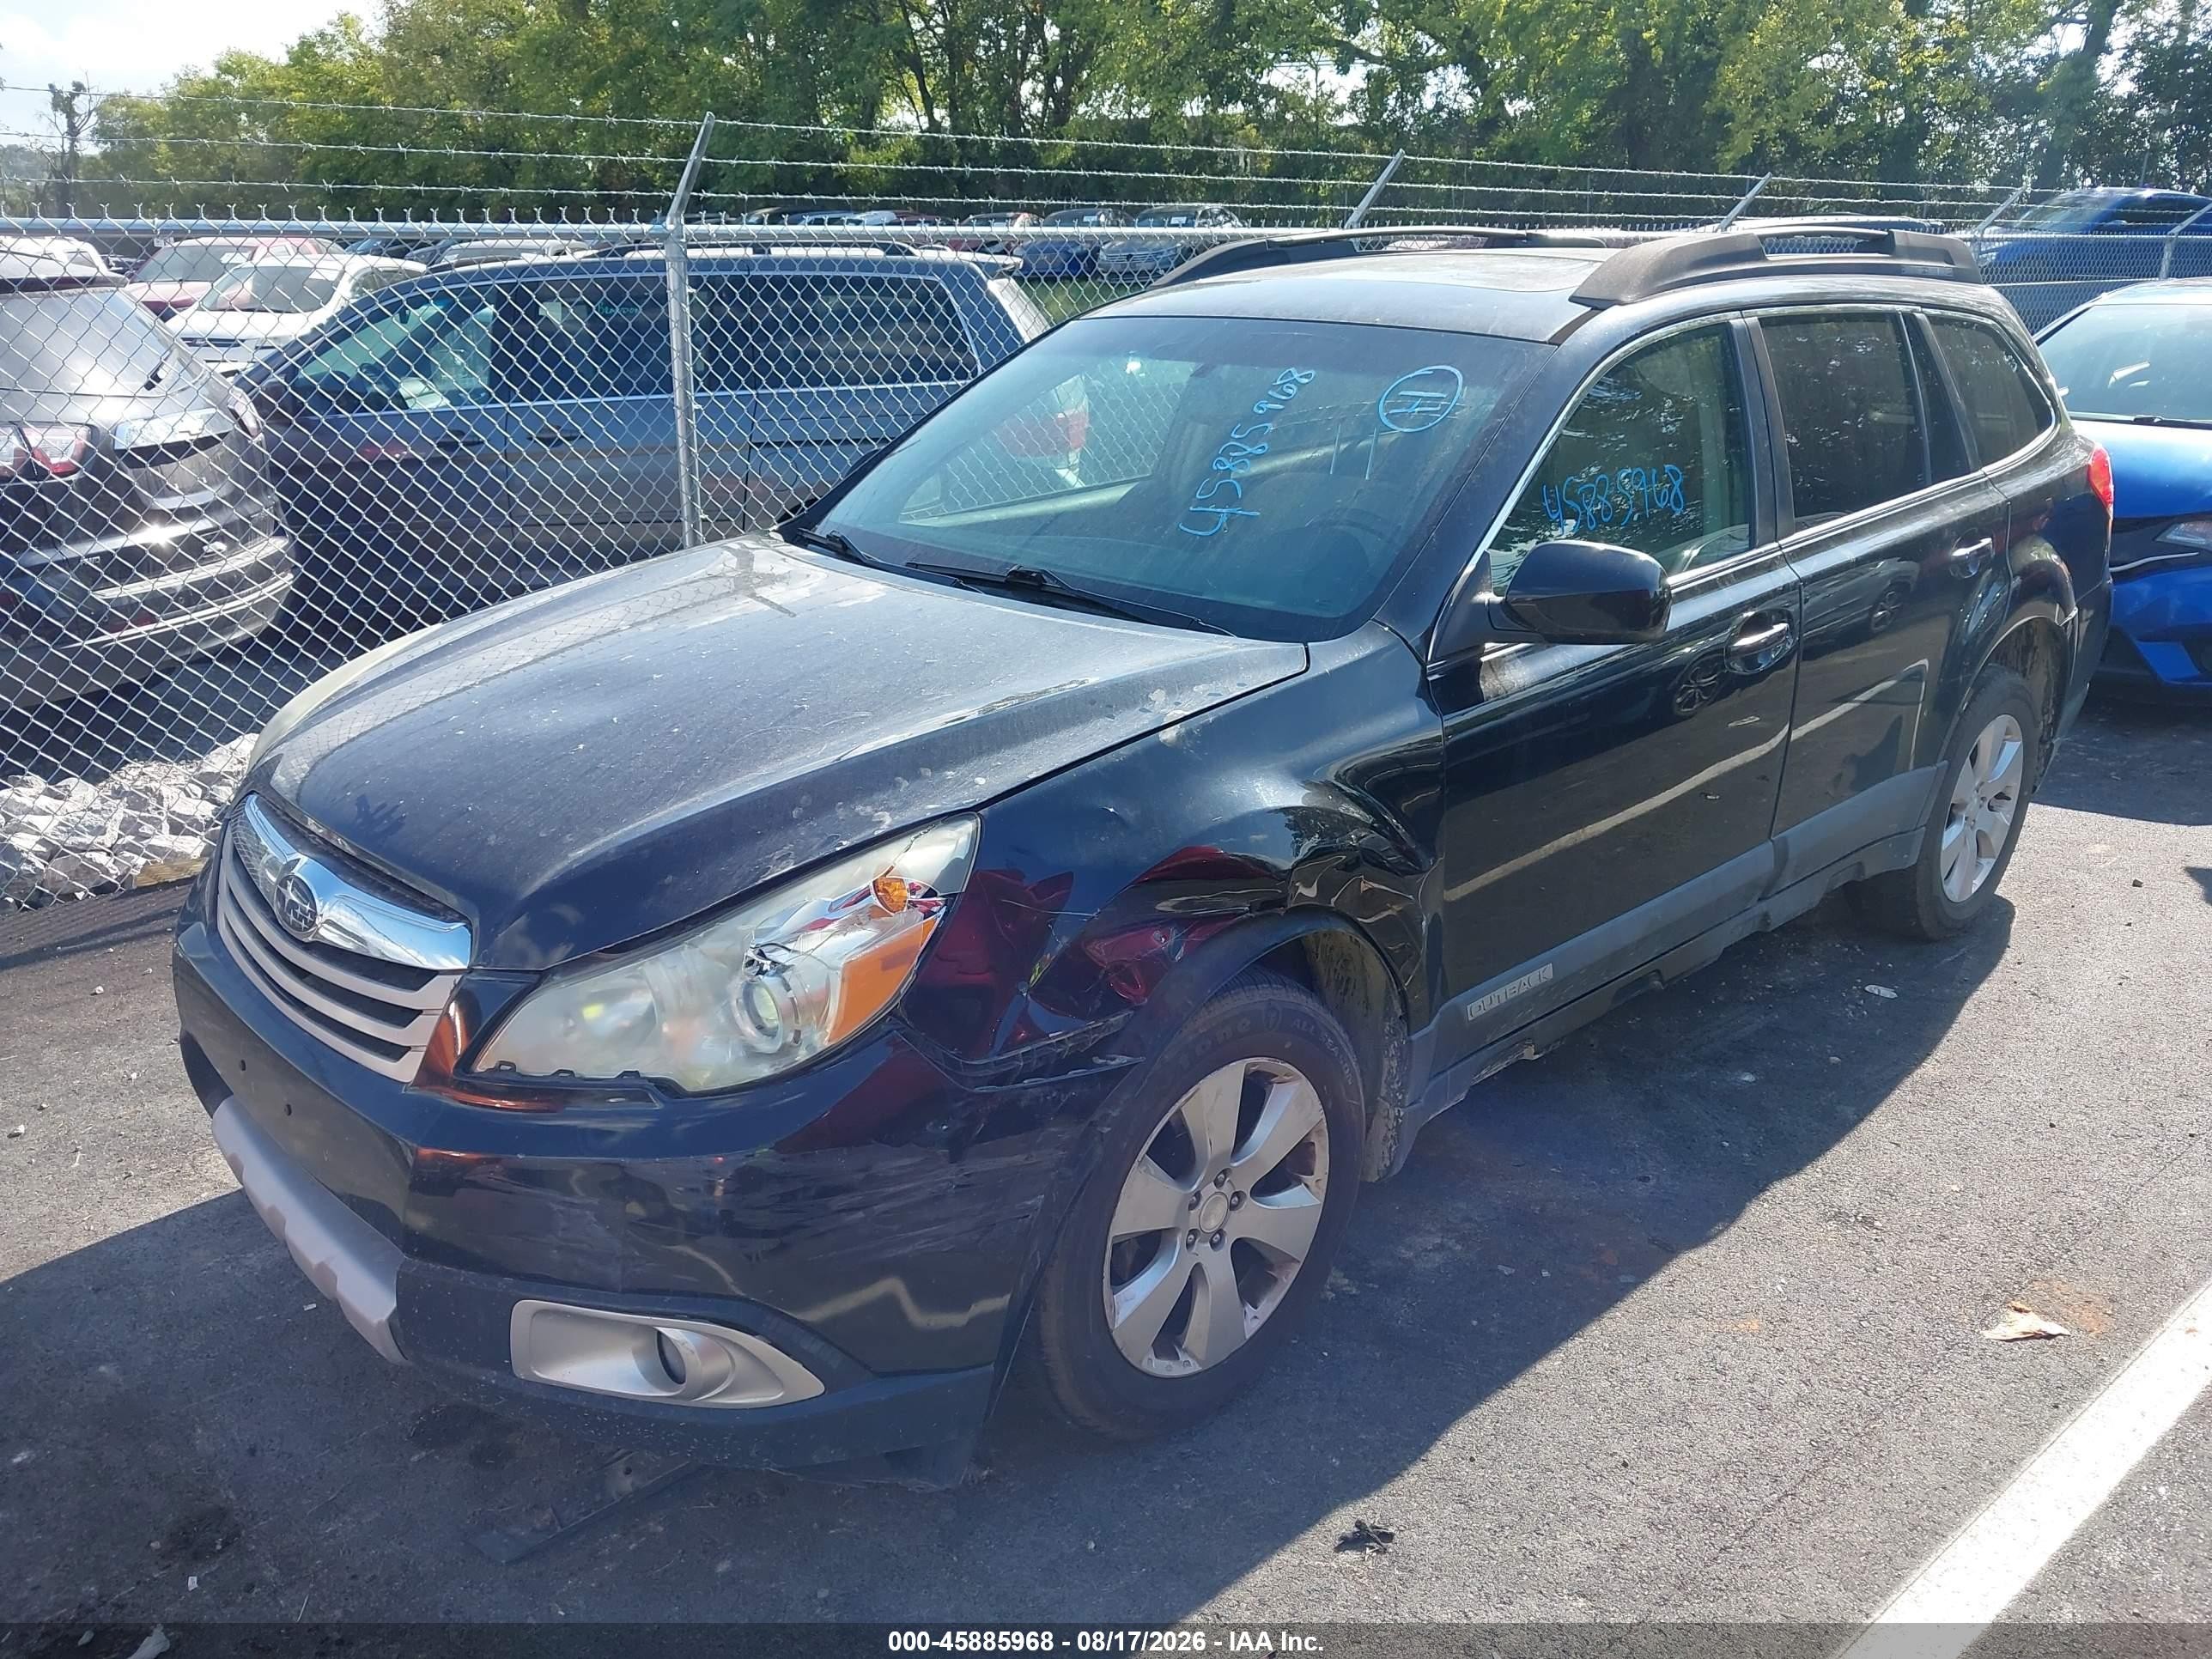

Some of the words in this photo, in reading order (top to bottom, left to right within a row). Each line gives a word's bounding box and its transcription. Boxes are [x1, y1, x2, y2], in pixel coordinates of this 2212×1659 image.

[1178, 366, 1316, 537] 45885968
[1542, 464, 1684, 537] 45885968
[1468, 964, 1551, 1018] OUTBACK
